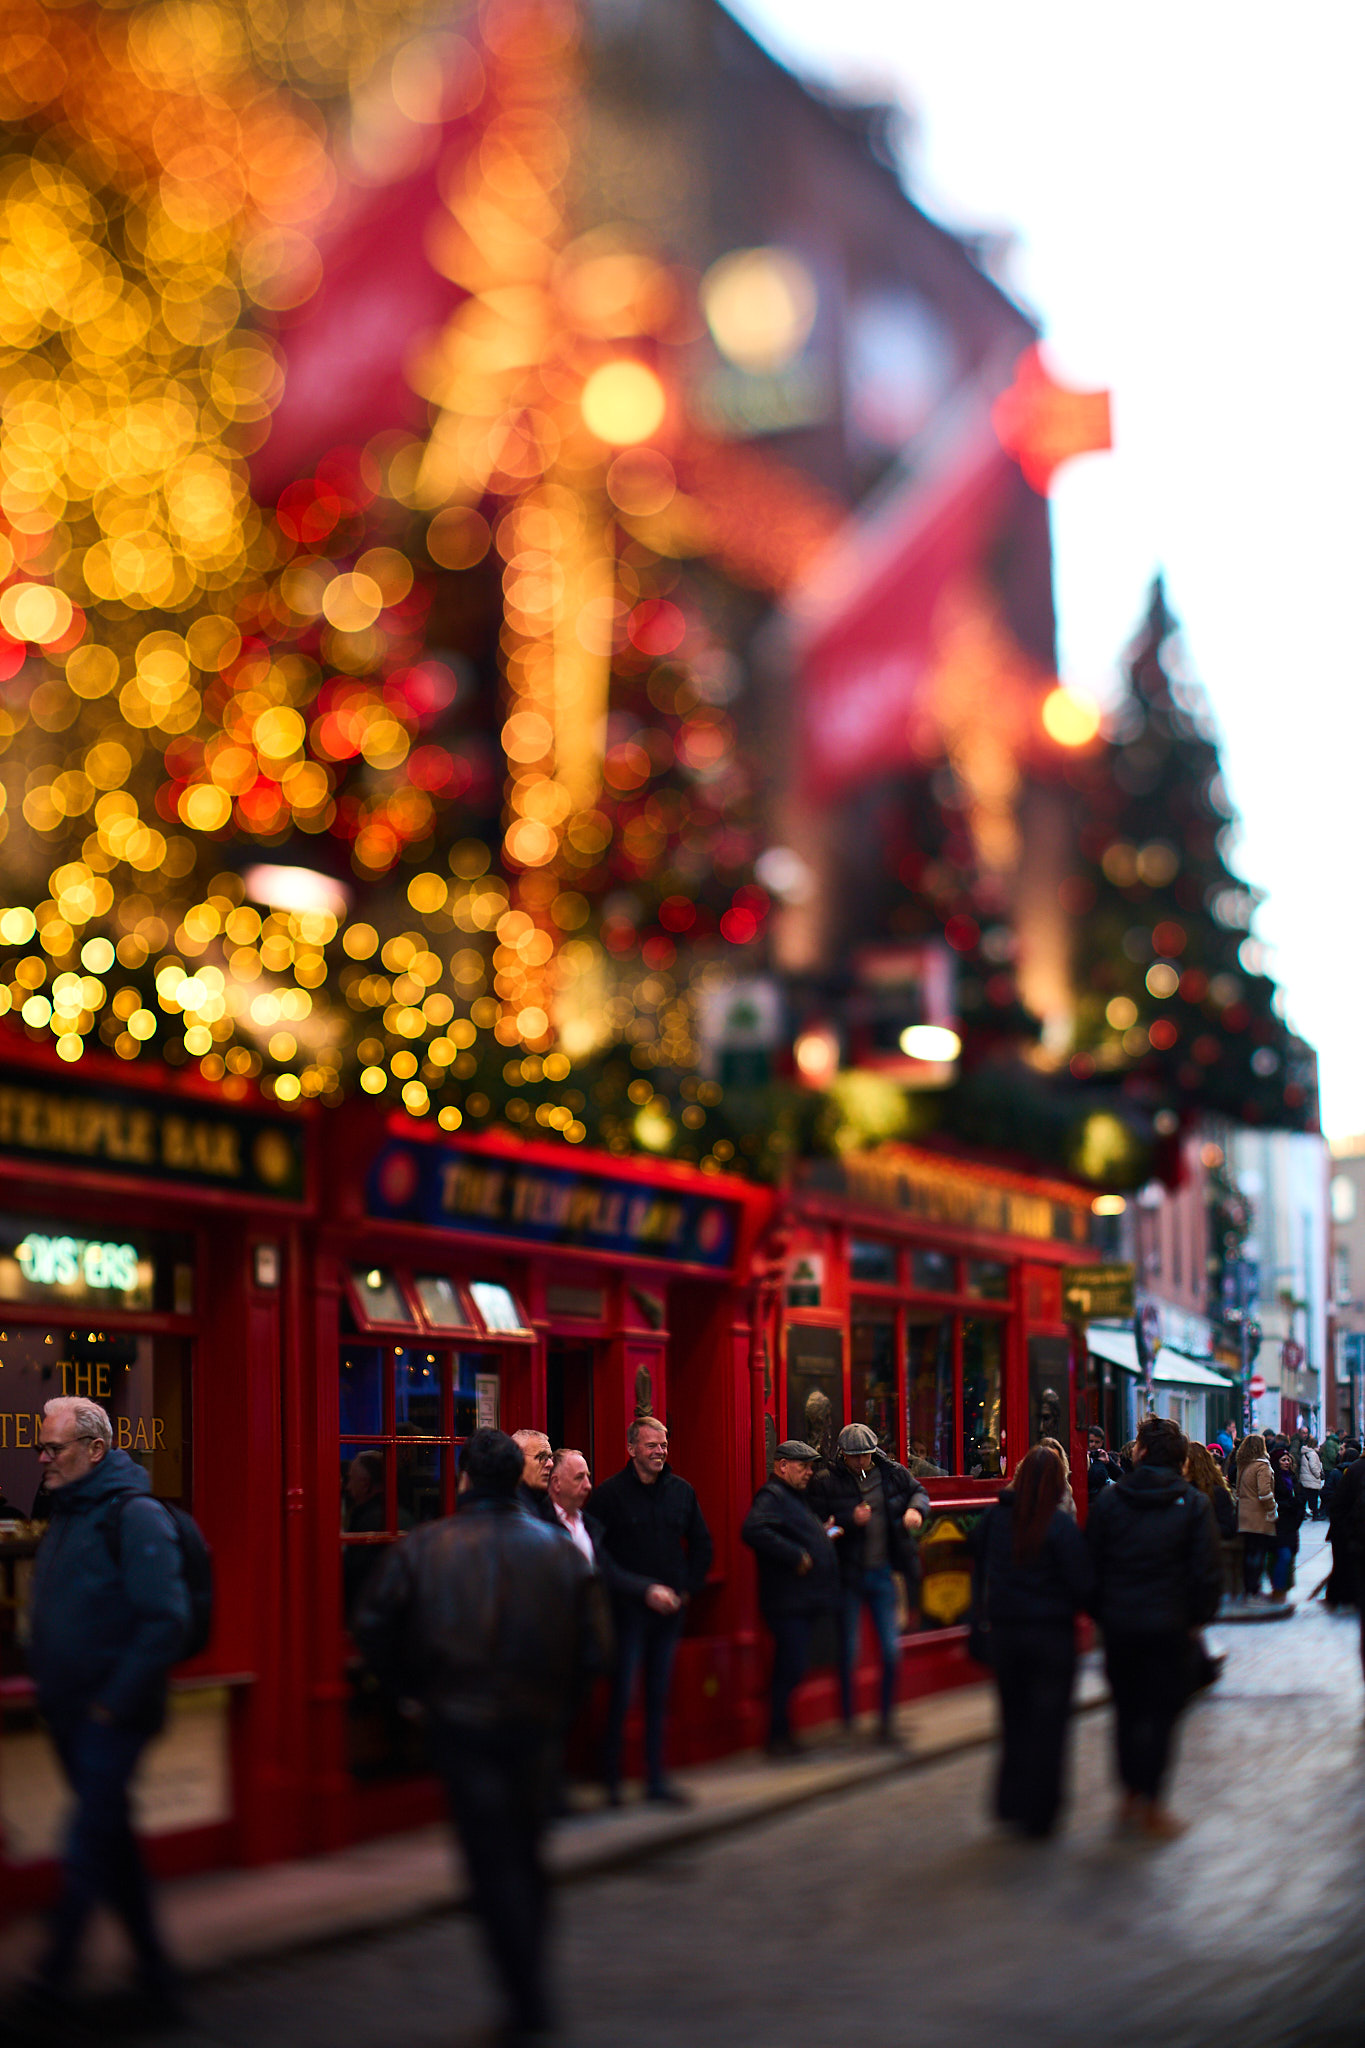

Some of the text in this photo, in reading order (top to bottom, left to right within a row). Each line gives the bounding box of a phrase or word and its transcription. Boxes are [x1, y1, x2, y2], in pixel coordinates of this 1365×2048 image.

[161, 1113, 242, 1178] BAR
[440, 1162, 686, 1244] THE TEMPLE BAR
[55, 1360, 112, 1398] THE
[117, 1416, 167, 1450] BAR
